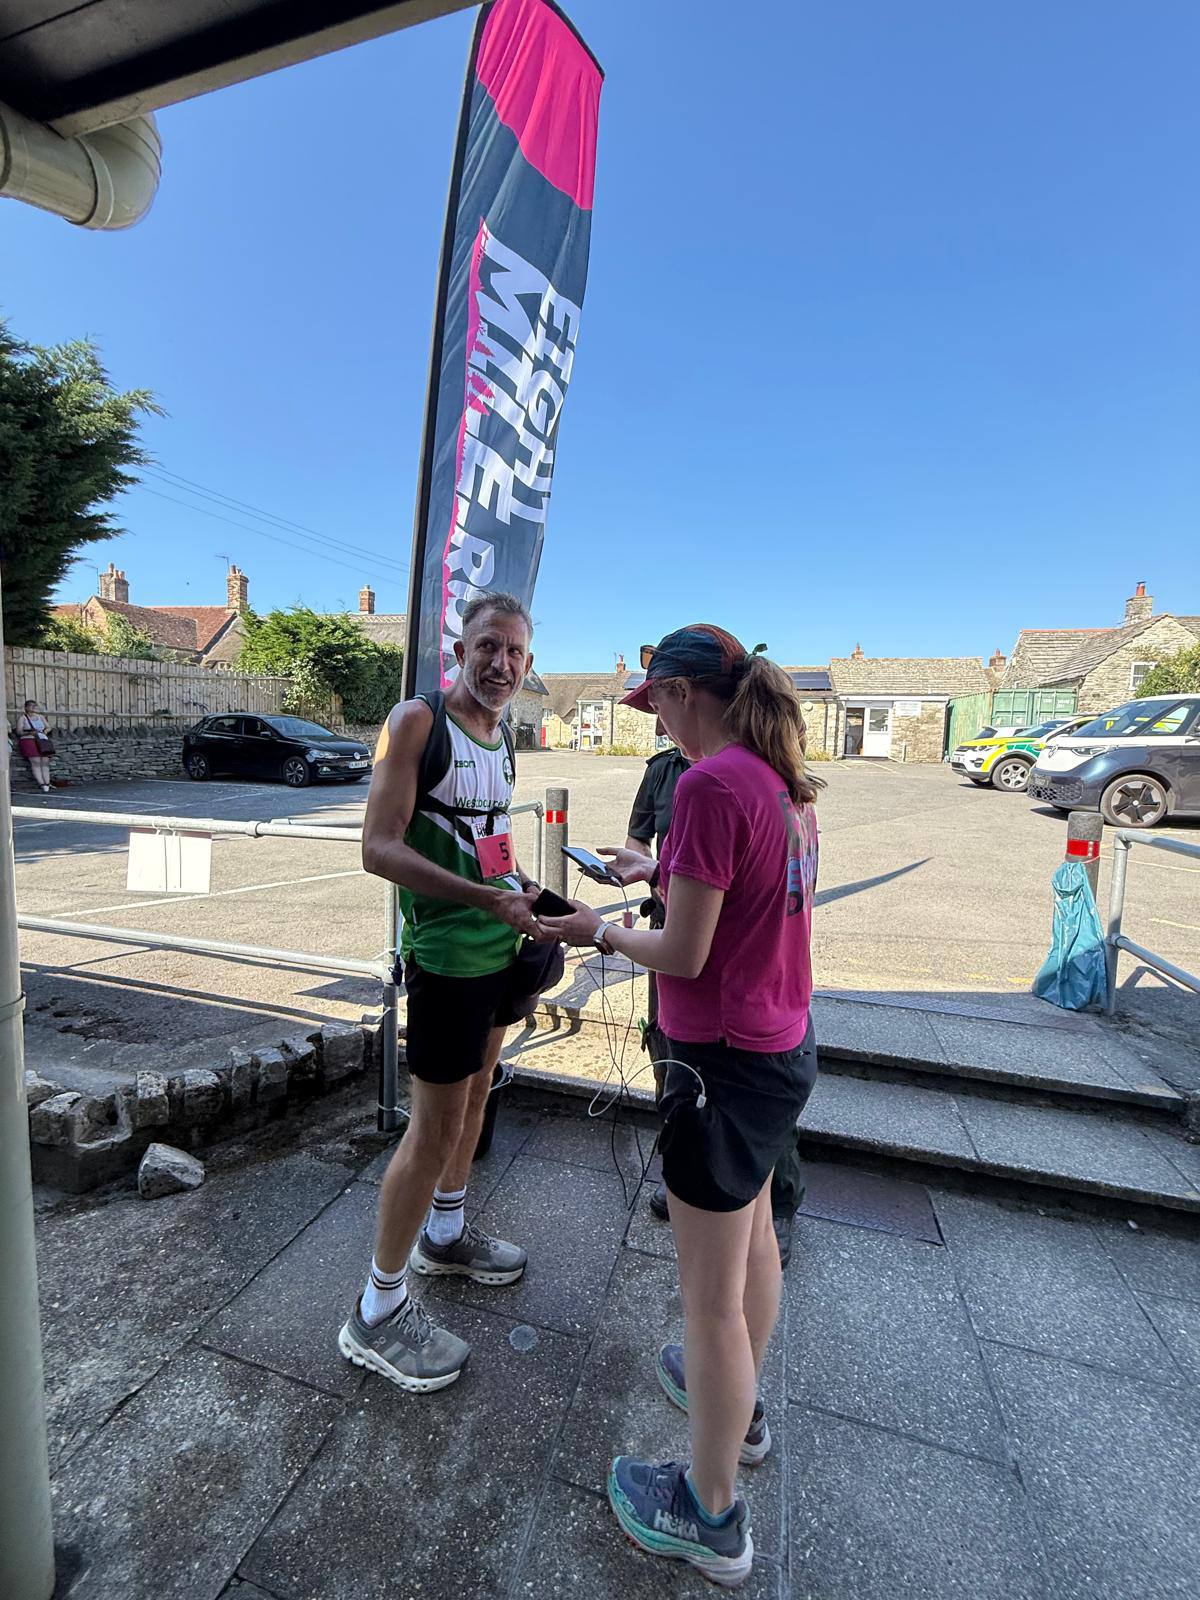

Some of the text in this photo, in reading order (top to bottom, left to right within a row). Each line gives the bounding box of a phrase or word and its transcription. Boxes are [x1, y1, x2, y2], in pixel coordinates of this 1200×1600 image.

[457, 221, 550, 525] MILE
[511, 284, 582, 524] EIGHT
[498, 841, 510, 861] 5
